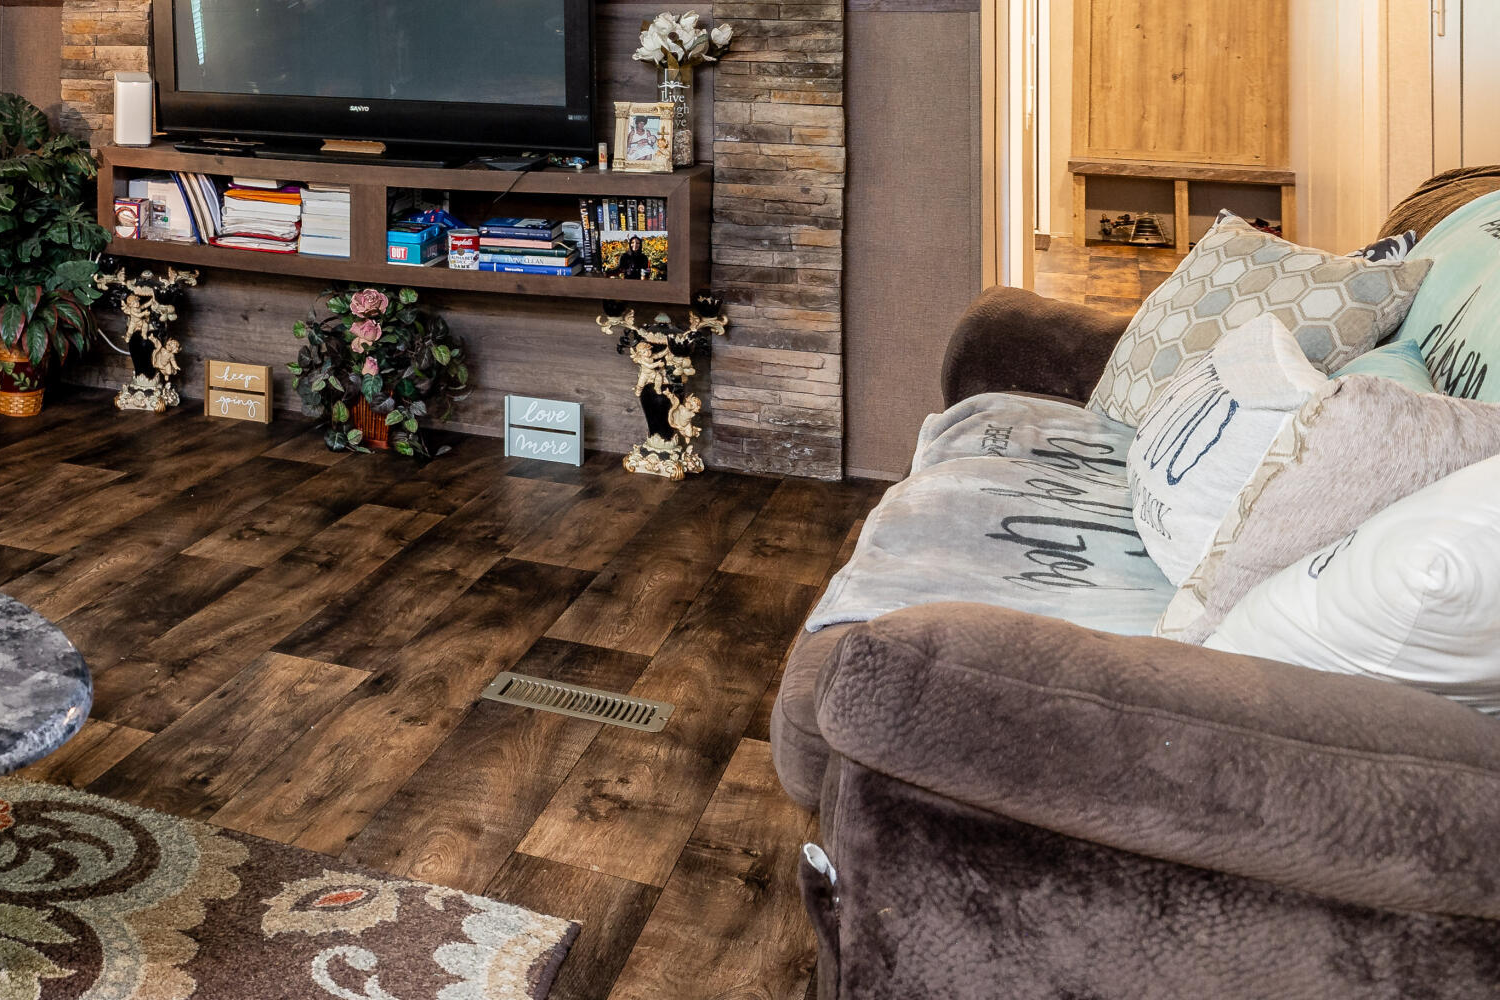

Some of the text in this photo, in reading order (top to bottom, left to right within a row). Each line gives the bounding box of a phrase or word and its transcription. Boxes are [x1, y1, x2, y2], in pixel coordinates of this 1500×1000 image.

[215, 365, 261, 389] keep
[215, 396, 261, 418] going
[519, 400, 571, 423] love
[515, 434, 572, 455] more
